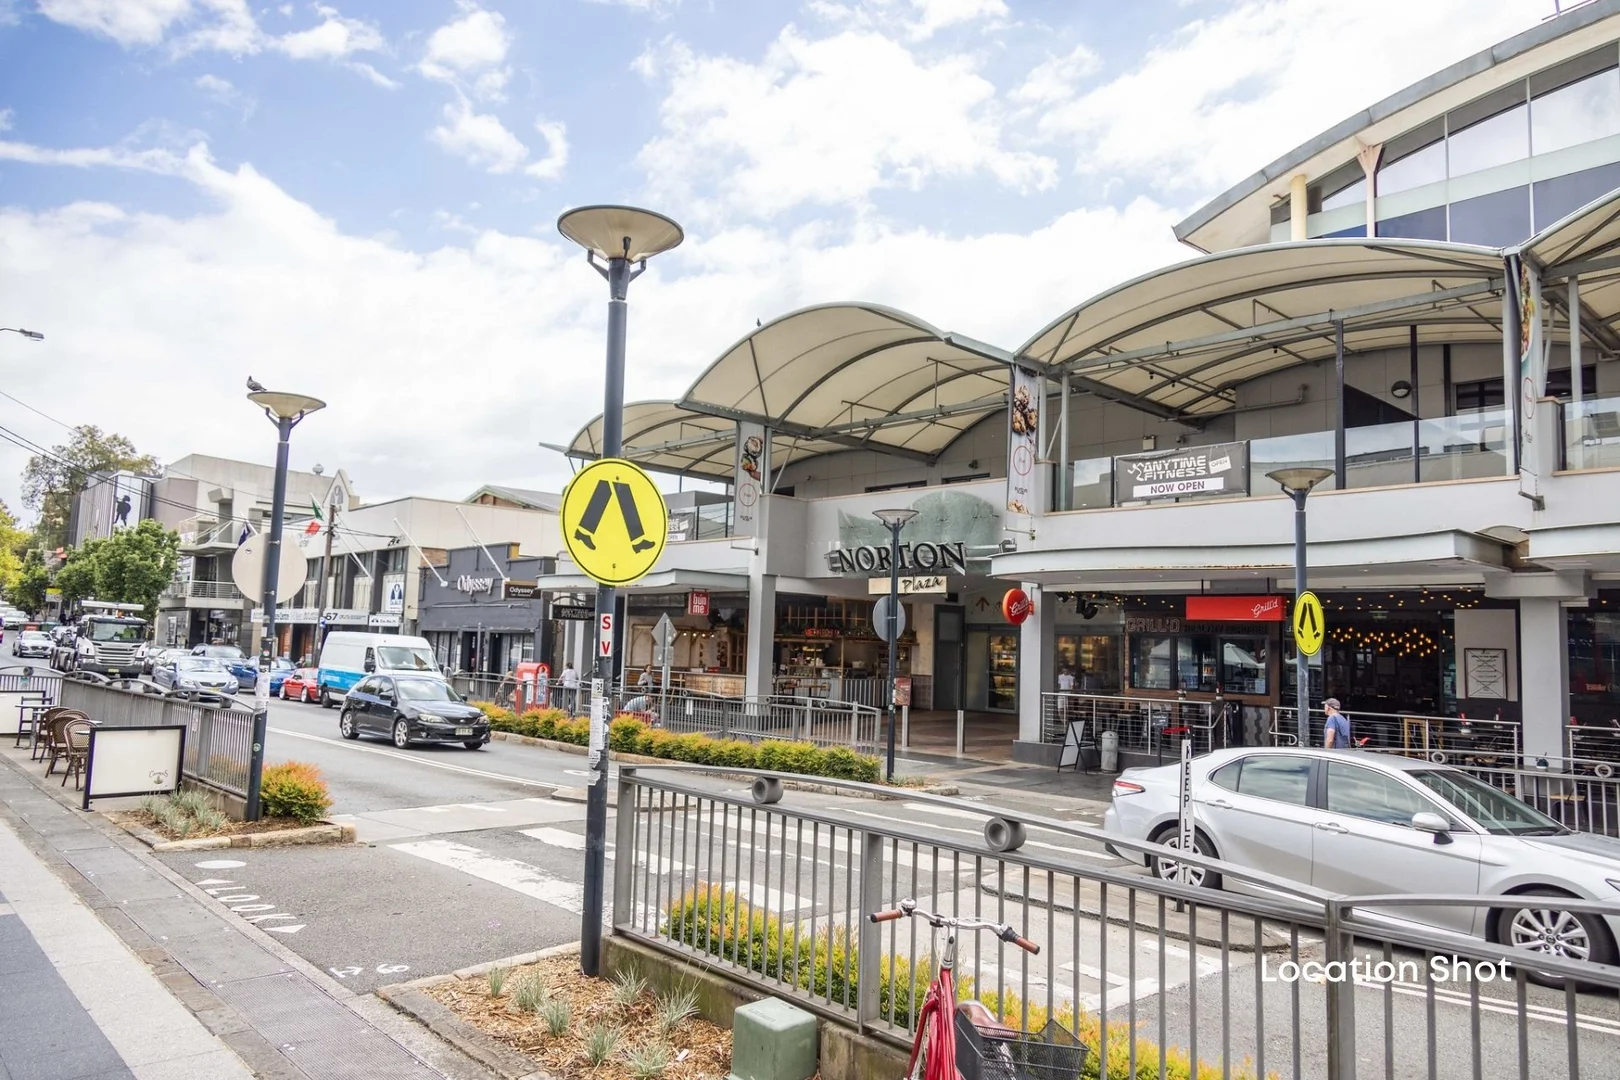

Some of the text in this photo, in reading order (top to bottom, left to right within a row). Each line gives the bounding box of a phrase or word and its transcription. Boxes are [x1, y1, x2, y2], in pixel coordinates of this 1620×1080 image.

[1143, 455, 1206, 472] ANYTIME
[1210, 459, 1228, 468] OPEN
[1144, 466, 1207, 481] FITNESS
[1150, 480, 1205, 494] NOW OPEN
[835, 541, 966, 574] NORTON
[457, 574, 494, 596] Odyssey
[509, 586, 535, 595] Odyssey
[901, 574, 944, 594] Plaza
[1251, 599, 1279, 618] Grill'd
[1126, 617, 1180, 633] GRILL'D
[1181, 745, 1191, 884] KEEP LET
[204, 886, 298, 923] LOOK
